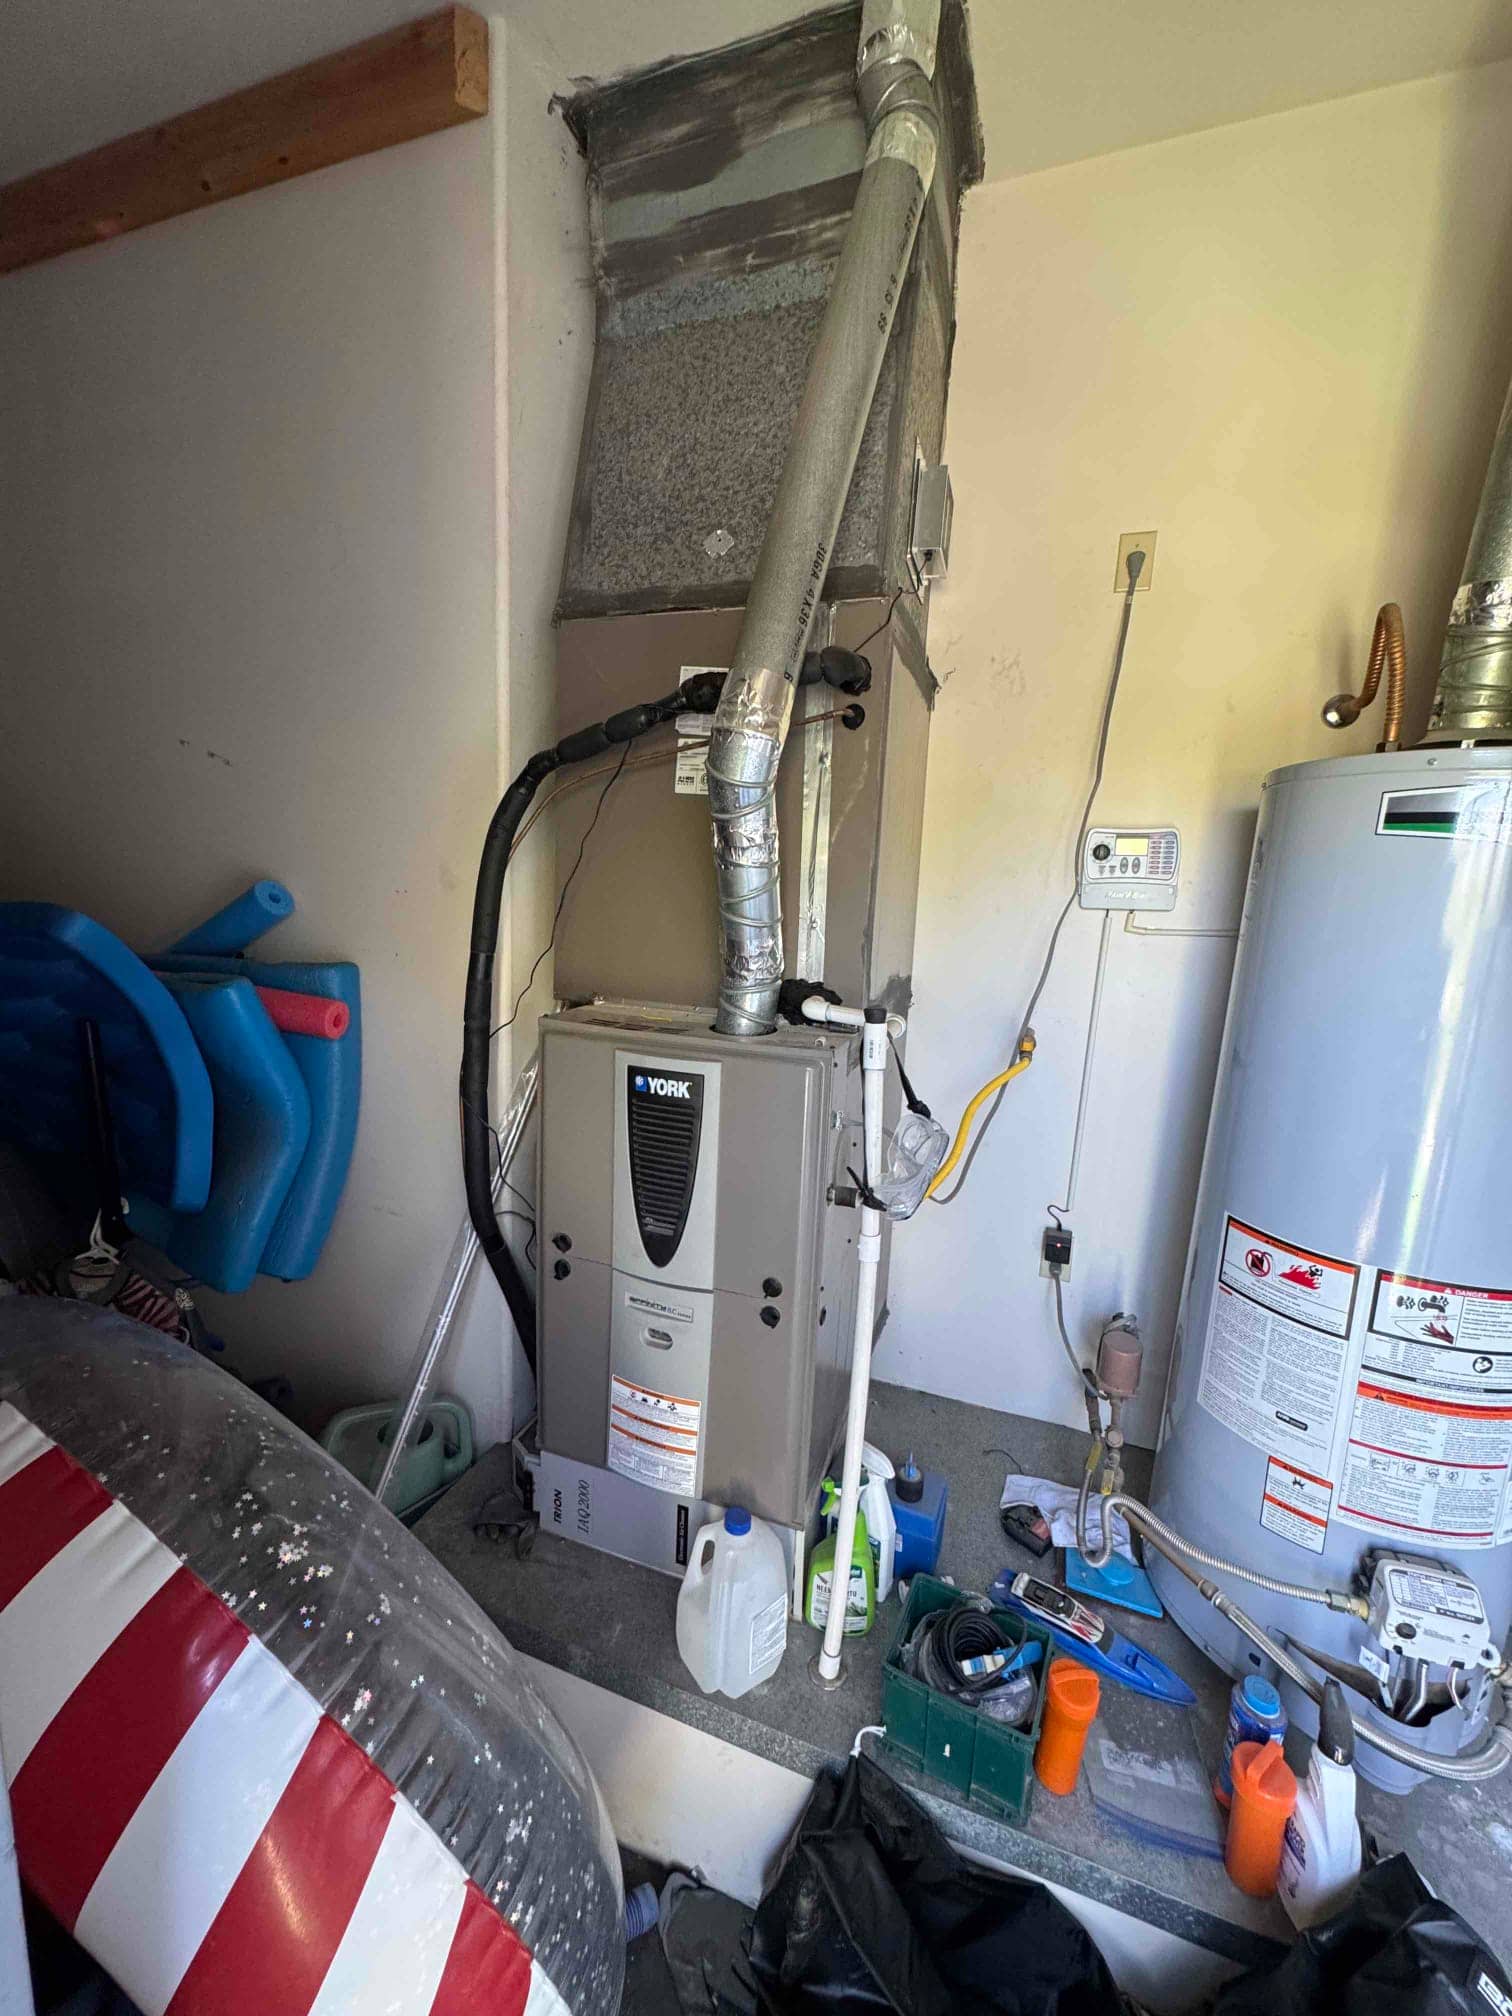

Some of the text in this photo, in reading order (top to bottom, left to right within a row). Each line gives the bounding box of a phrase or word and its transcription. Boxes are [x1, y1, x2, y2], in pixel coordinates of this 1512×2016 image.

[648, 1076, 690, 1099] YORK
[1455, 1289, 1489, 1299] DANGER
[553, 1488, 563, 1525] TRION
[577, 1479, 591, 1534] IAQ2000
